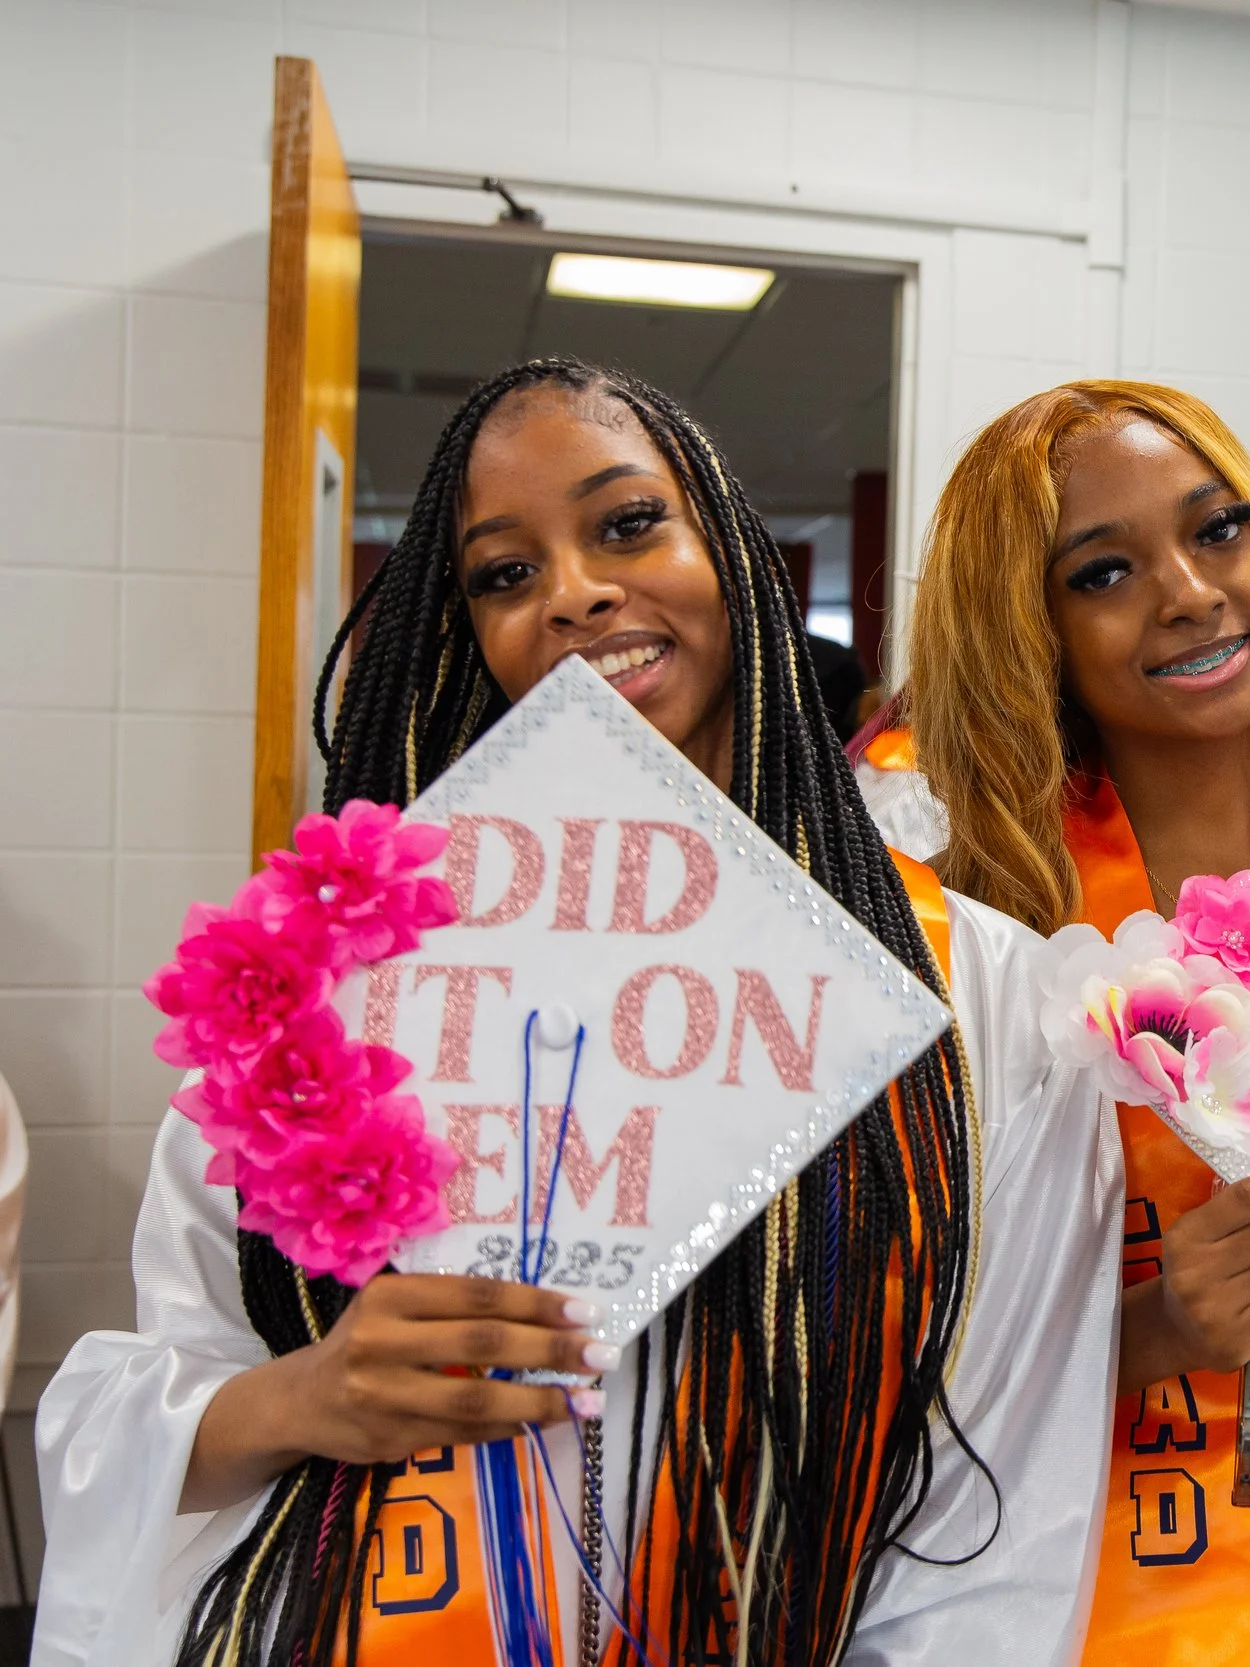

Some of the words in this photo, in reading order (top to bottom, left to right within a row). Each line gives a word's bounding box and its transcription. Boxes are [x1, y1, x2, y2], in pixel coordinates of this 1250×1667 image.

[443, 812, 719, 936] DID
[357, 962, 513, 1083] IT
[611, 962, 833, 1093] ON
[439, 1102, 665, 1229] EM
